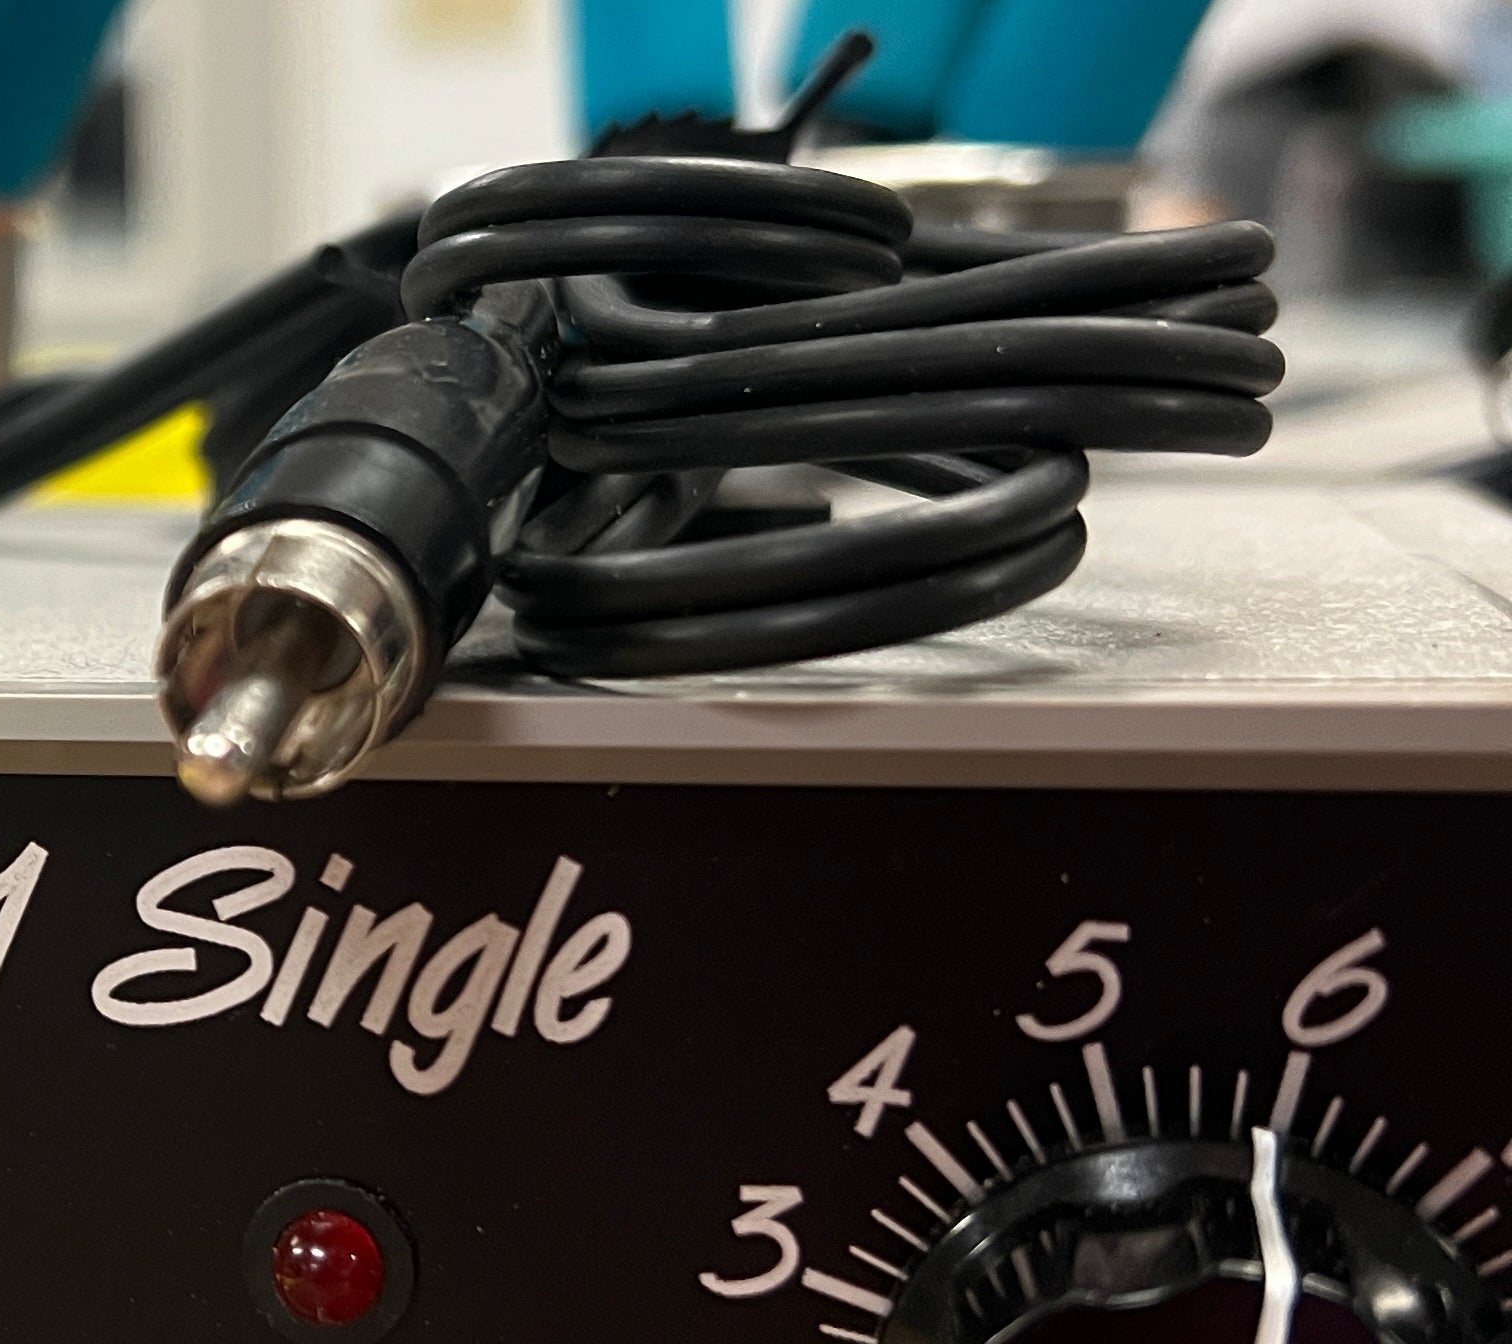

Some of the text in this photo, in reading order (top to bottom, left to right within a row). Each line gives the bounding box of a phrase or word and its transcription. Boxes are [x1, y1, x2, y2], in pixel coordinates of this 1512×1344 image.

[91, 845, 631, 1096] Single
[1015, 921, 1130, 1042] 5
[1282, 928, 1389, 1046] 6
[827, 1025, 917, 1138] 4
[699, 1185, 804, 1298] 3
